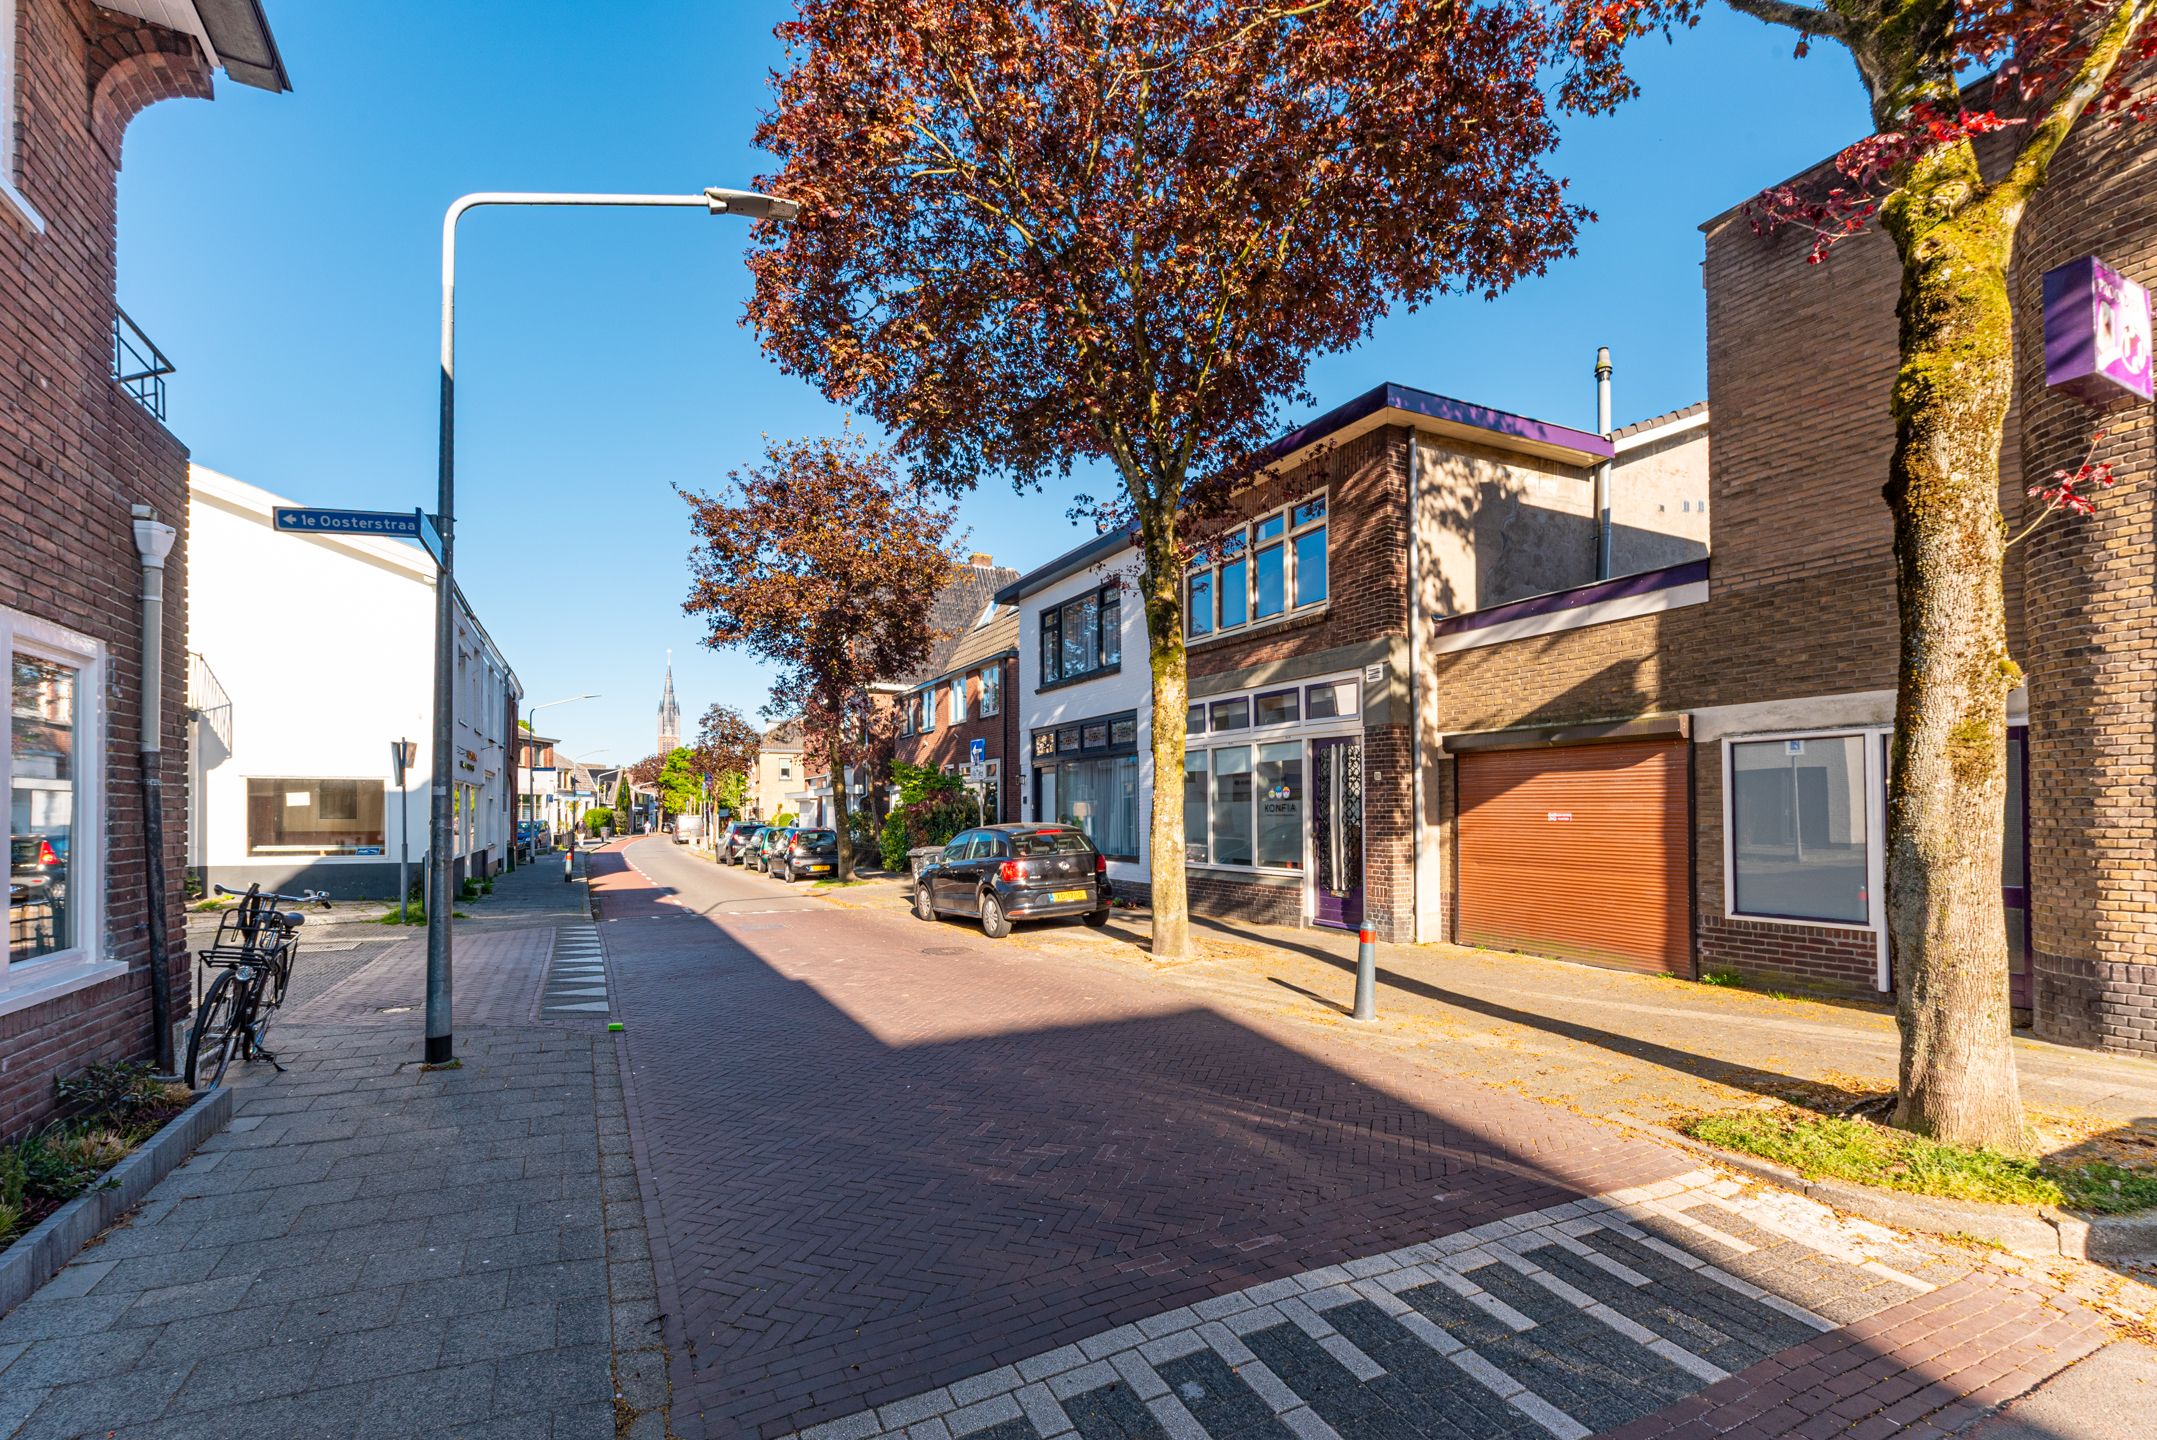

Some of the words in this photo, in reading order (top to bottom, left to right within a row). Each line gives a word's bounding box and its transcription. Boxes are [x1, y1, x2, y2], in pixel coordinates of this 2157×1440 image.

[301, 514, 316, 526] 1e
[320, 515, 416, 531] Oosterstraa
[1264, 803, 1297, 813] KONFIA
